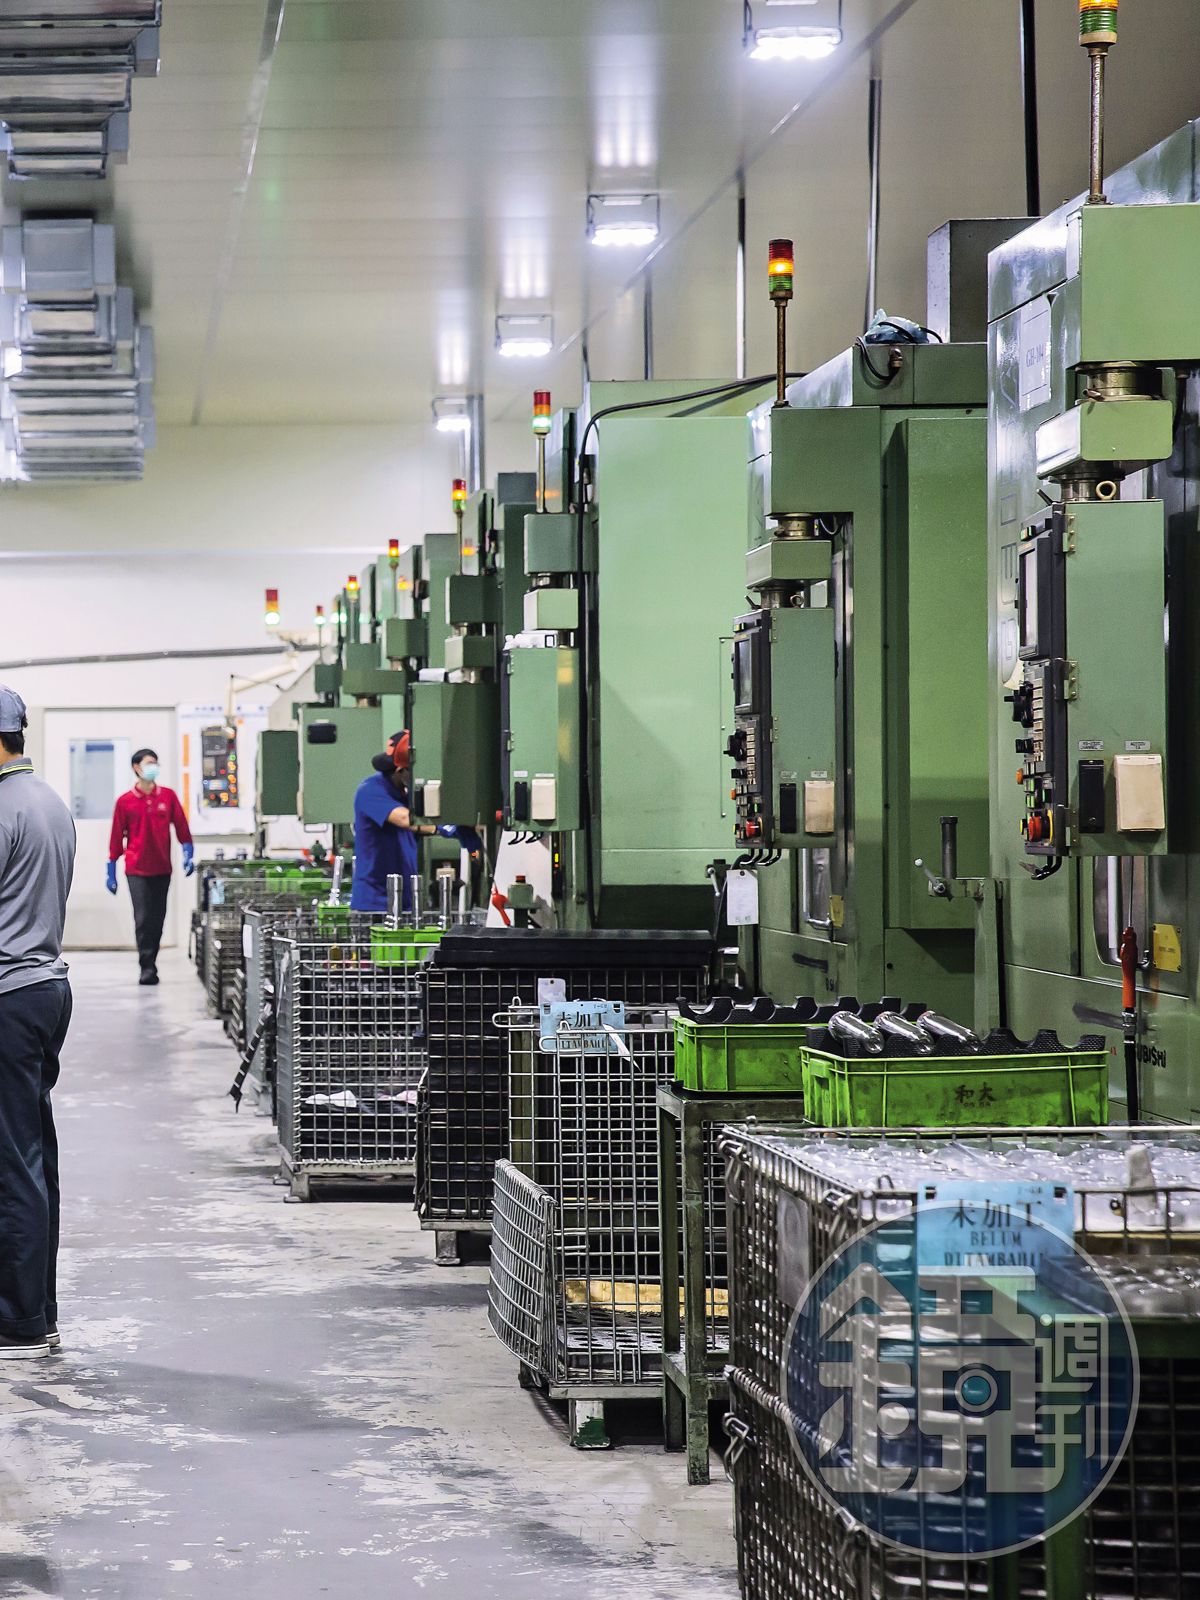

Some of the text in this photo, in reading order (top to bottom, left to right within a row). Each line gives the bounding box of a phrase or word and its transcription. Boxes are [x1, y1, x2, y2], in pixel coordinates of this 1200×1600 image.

[954, 1081, 996, 1104] 和大
[951, 1198, 1043, 1228] 未加工
[970, 1230, 1022, 1247] BELUM
